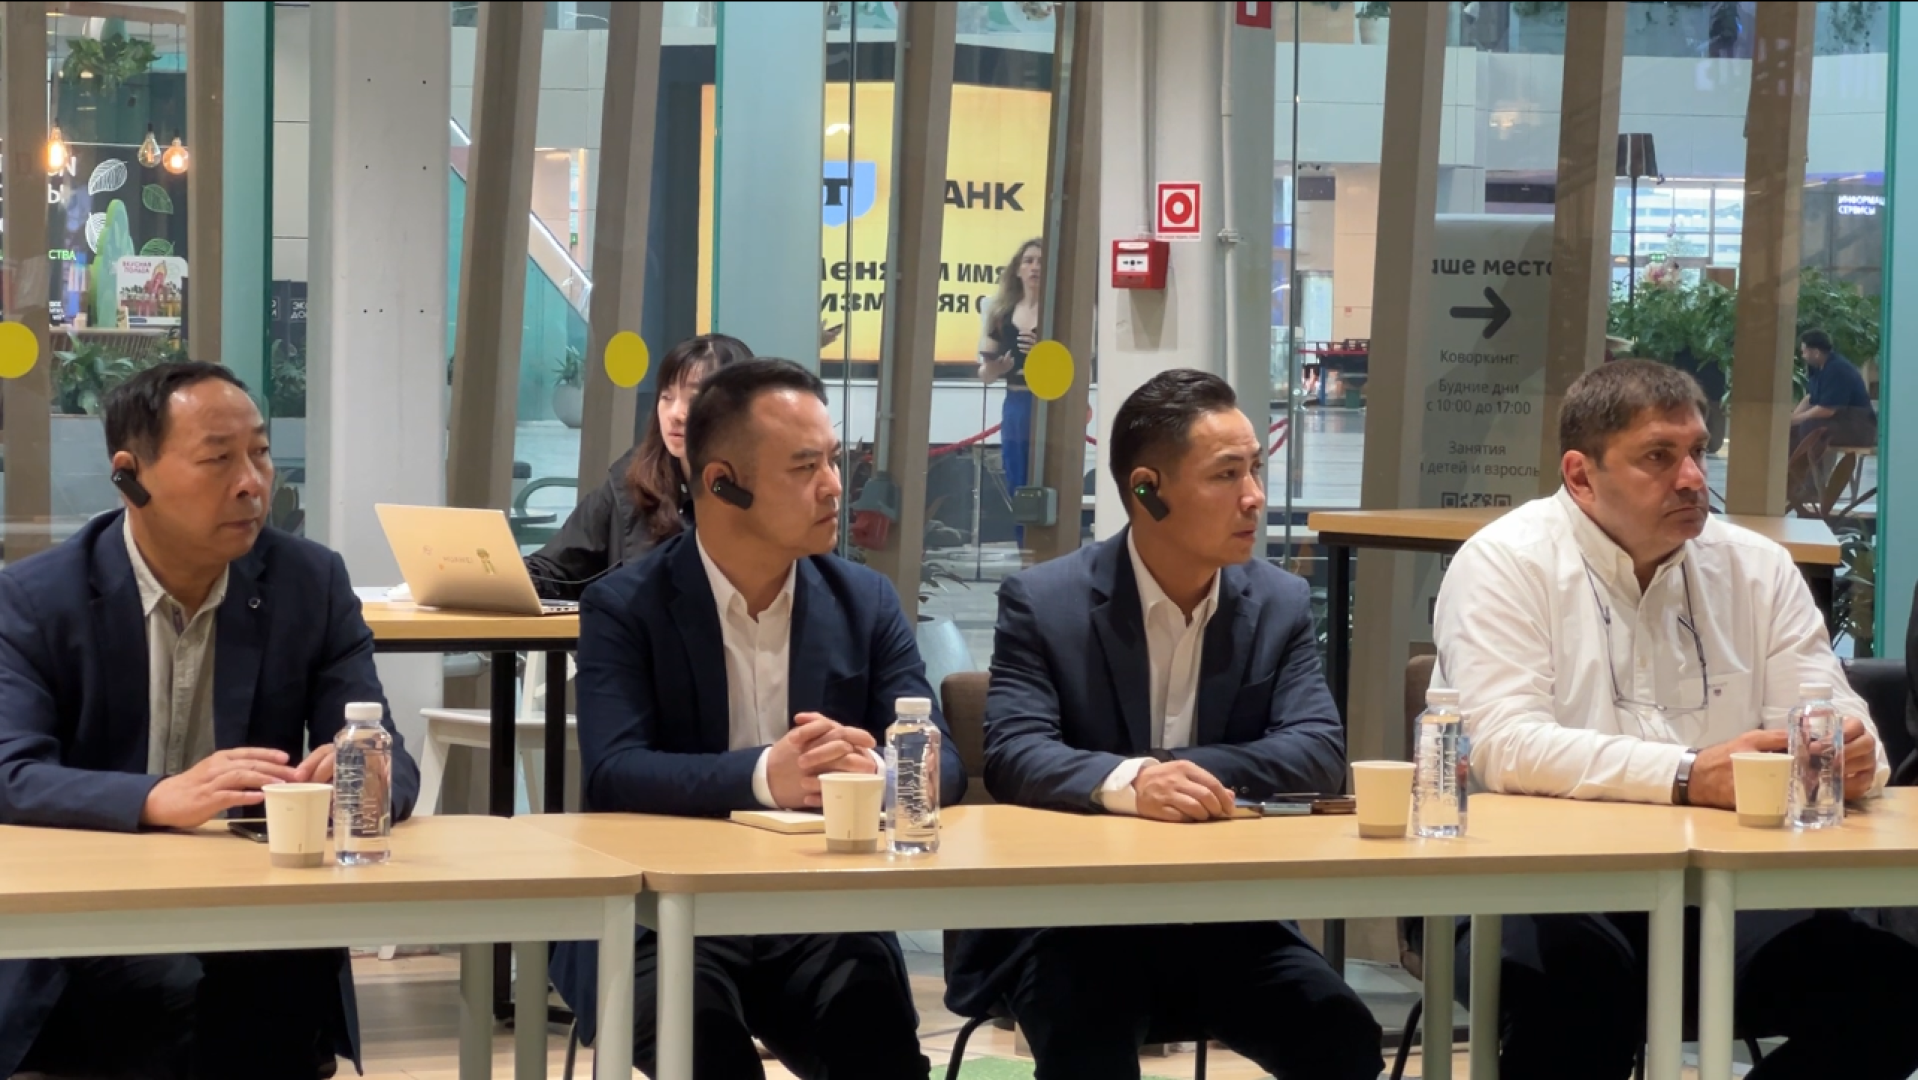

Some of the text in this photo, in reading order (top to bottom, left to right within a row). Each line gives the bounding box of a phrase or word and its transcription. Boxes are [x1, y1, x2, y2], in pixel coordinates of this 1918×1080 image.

[1440, 350, 1519, 367] Коворкинг:
[1439, 379, 1520, 397] Будние дни
[1437, 400, 1472, 413] 10:00
[1475, 403, 1493, 416] до
[1497, 402, 1532, 415] 17:00
[1449, 441, 1507, 455] Занятия
[1427, 460, 1468, 475] детей
[1471, 464, 1480, 474] и
